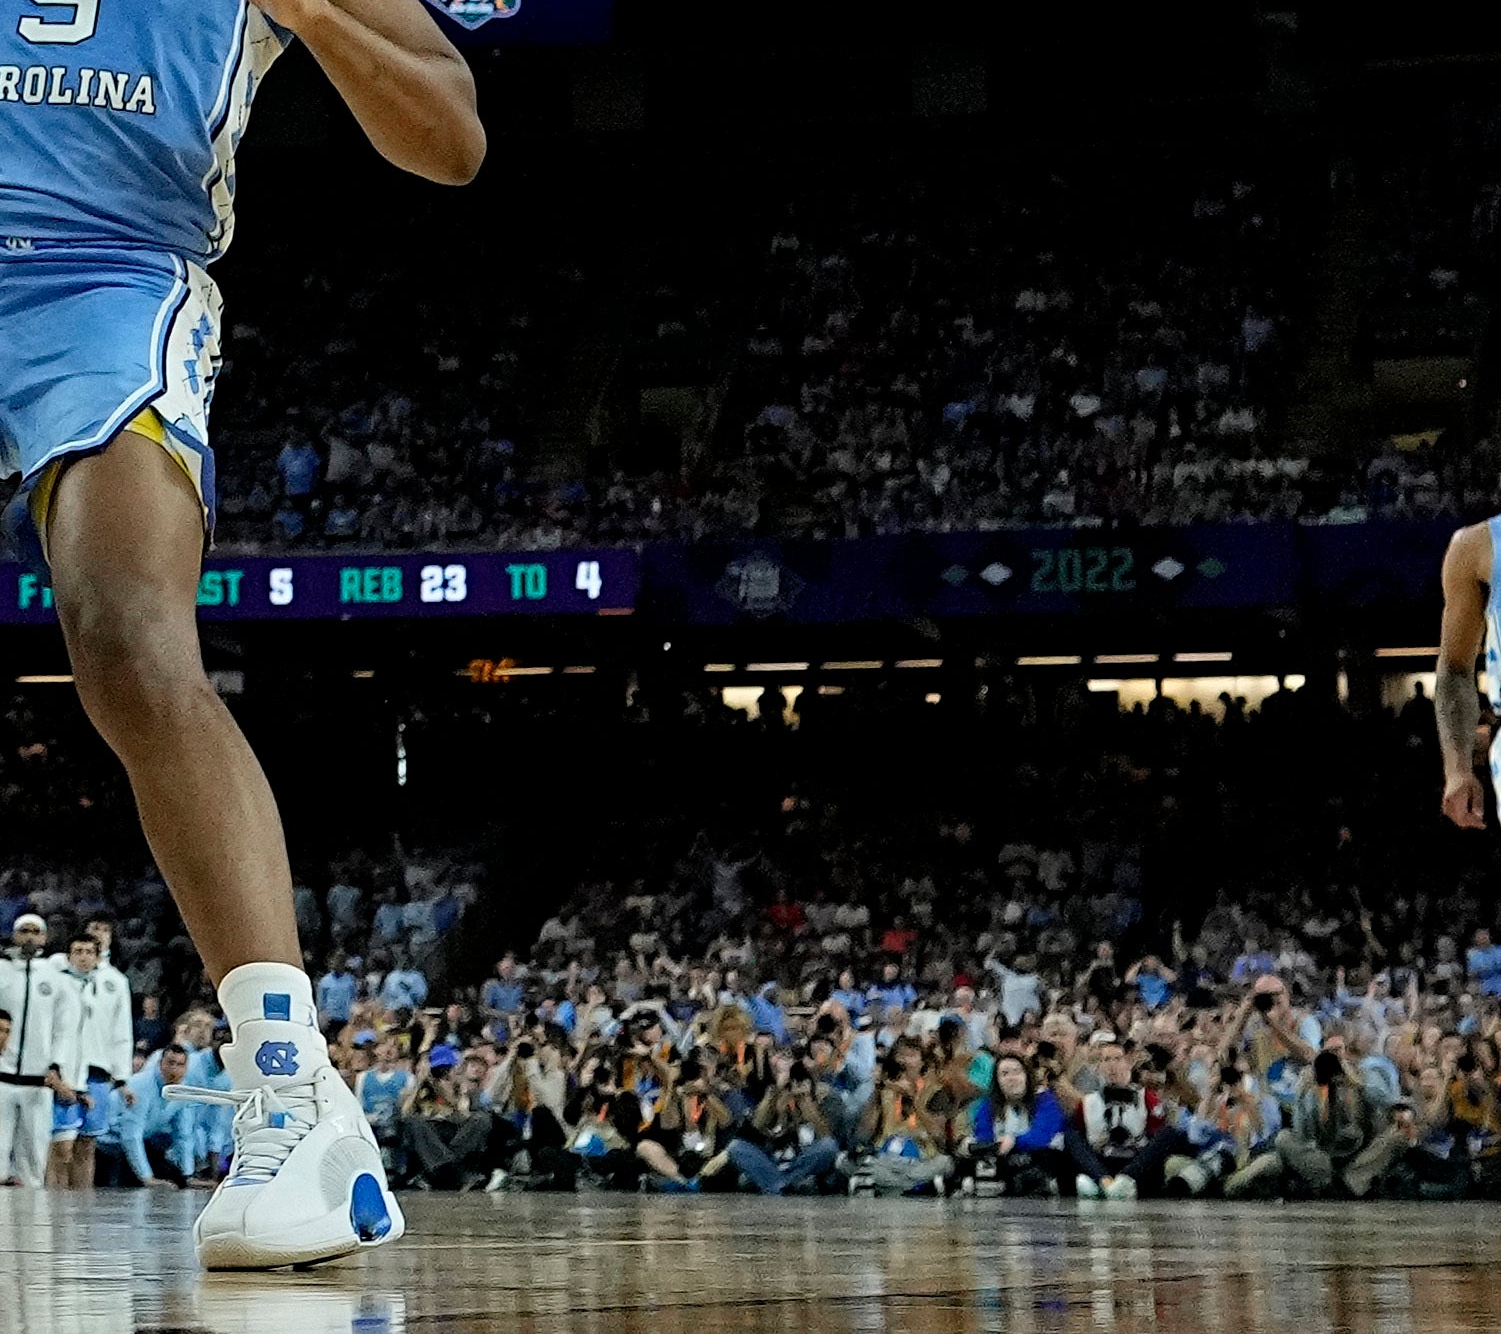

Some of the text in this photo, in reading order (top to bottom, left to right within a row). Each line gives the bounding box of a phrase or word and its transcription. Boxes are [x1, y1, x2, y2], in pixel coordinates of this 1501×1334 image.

[196, 569, 244, 607] ST
[268, 567, 294, 606] 5
[340, 567, 403, 604] REB
[419, 564, 469, 603] 23
[507, 562, 548, 600] TO
[574, 560, 602, 599] 4
[1028, 547, 1139, 593] 2022
